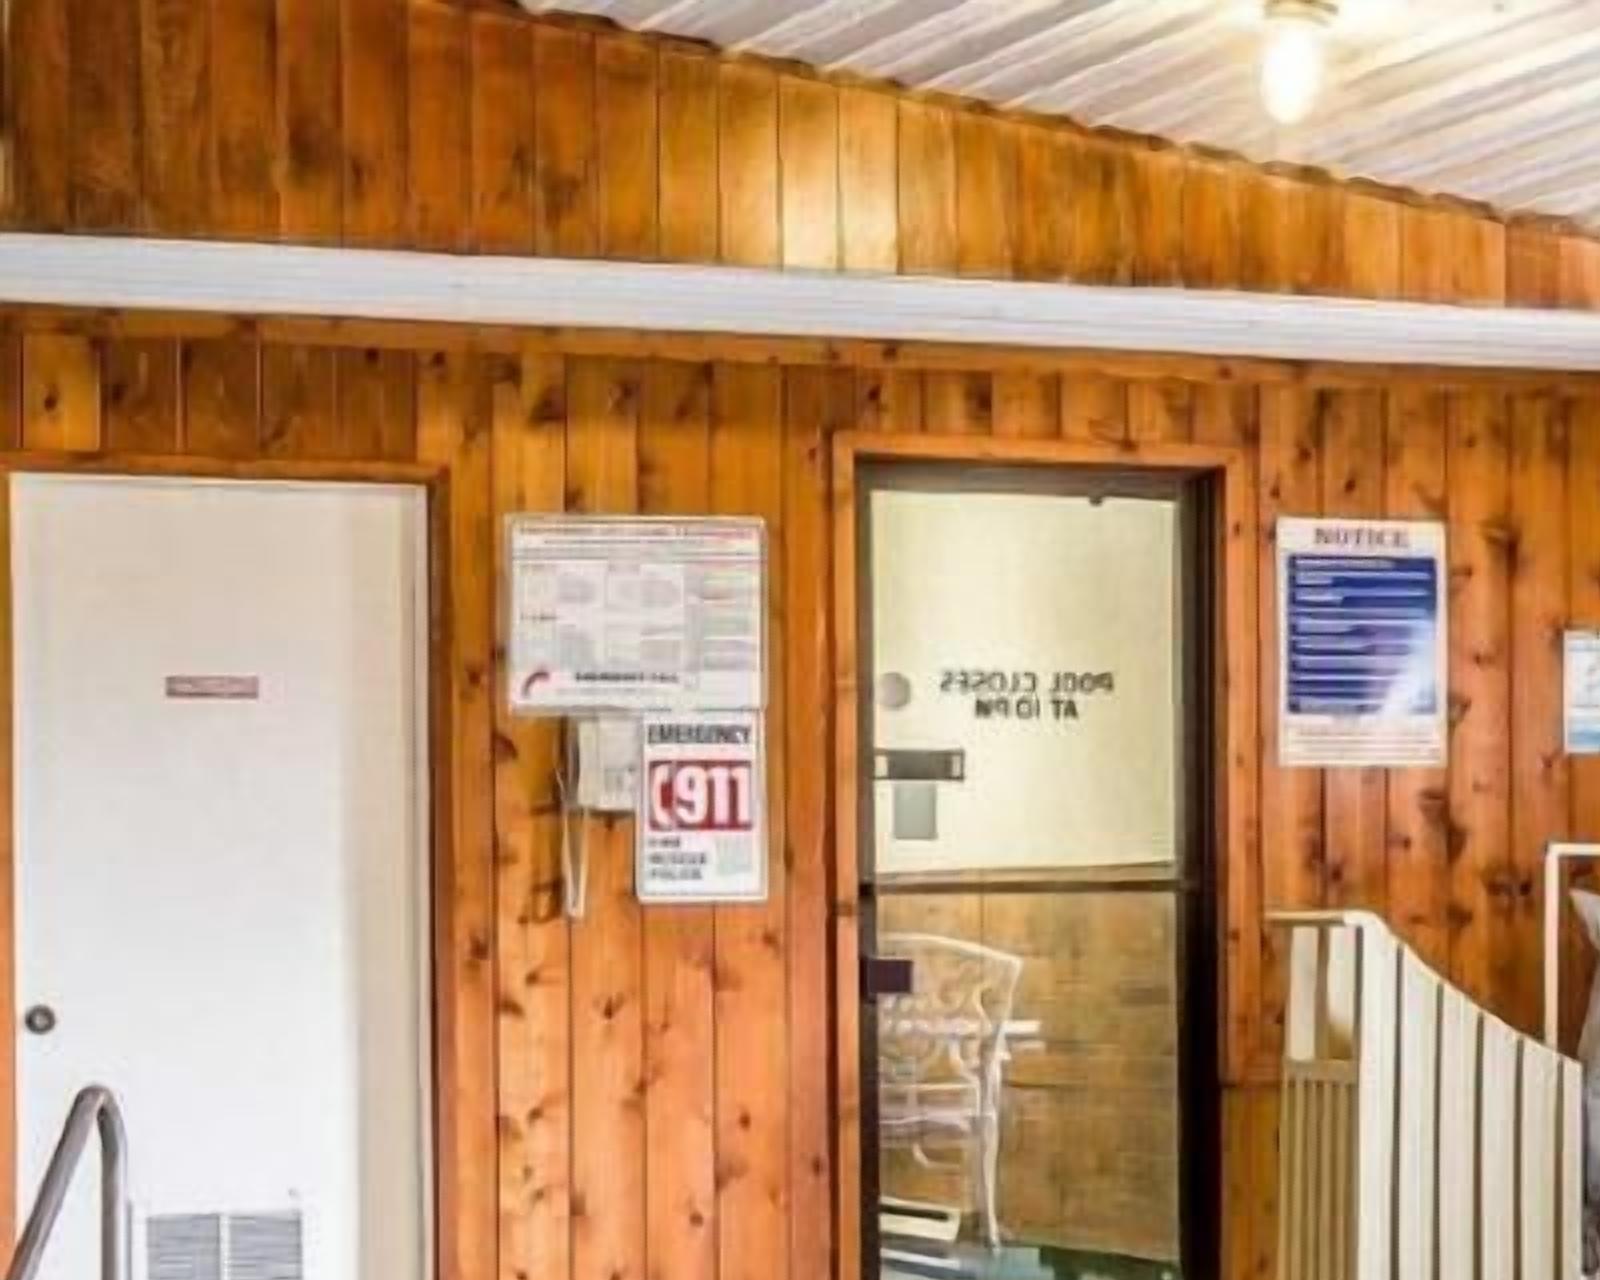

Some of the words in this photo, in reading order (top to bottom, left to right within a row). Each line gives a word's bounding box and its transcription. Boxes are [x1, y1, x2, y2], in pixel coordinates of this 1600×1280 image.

[1315, 527, 1409, 549] NOTICE
[648, 723, 752, 744] EMERGENCY
[675, 765, 752, 826] 911
